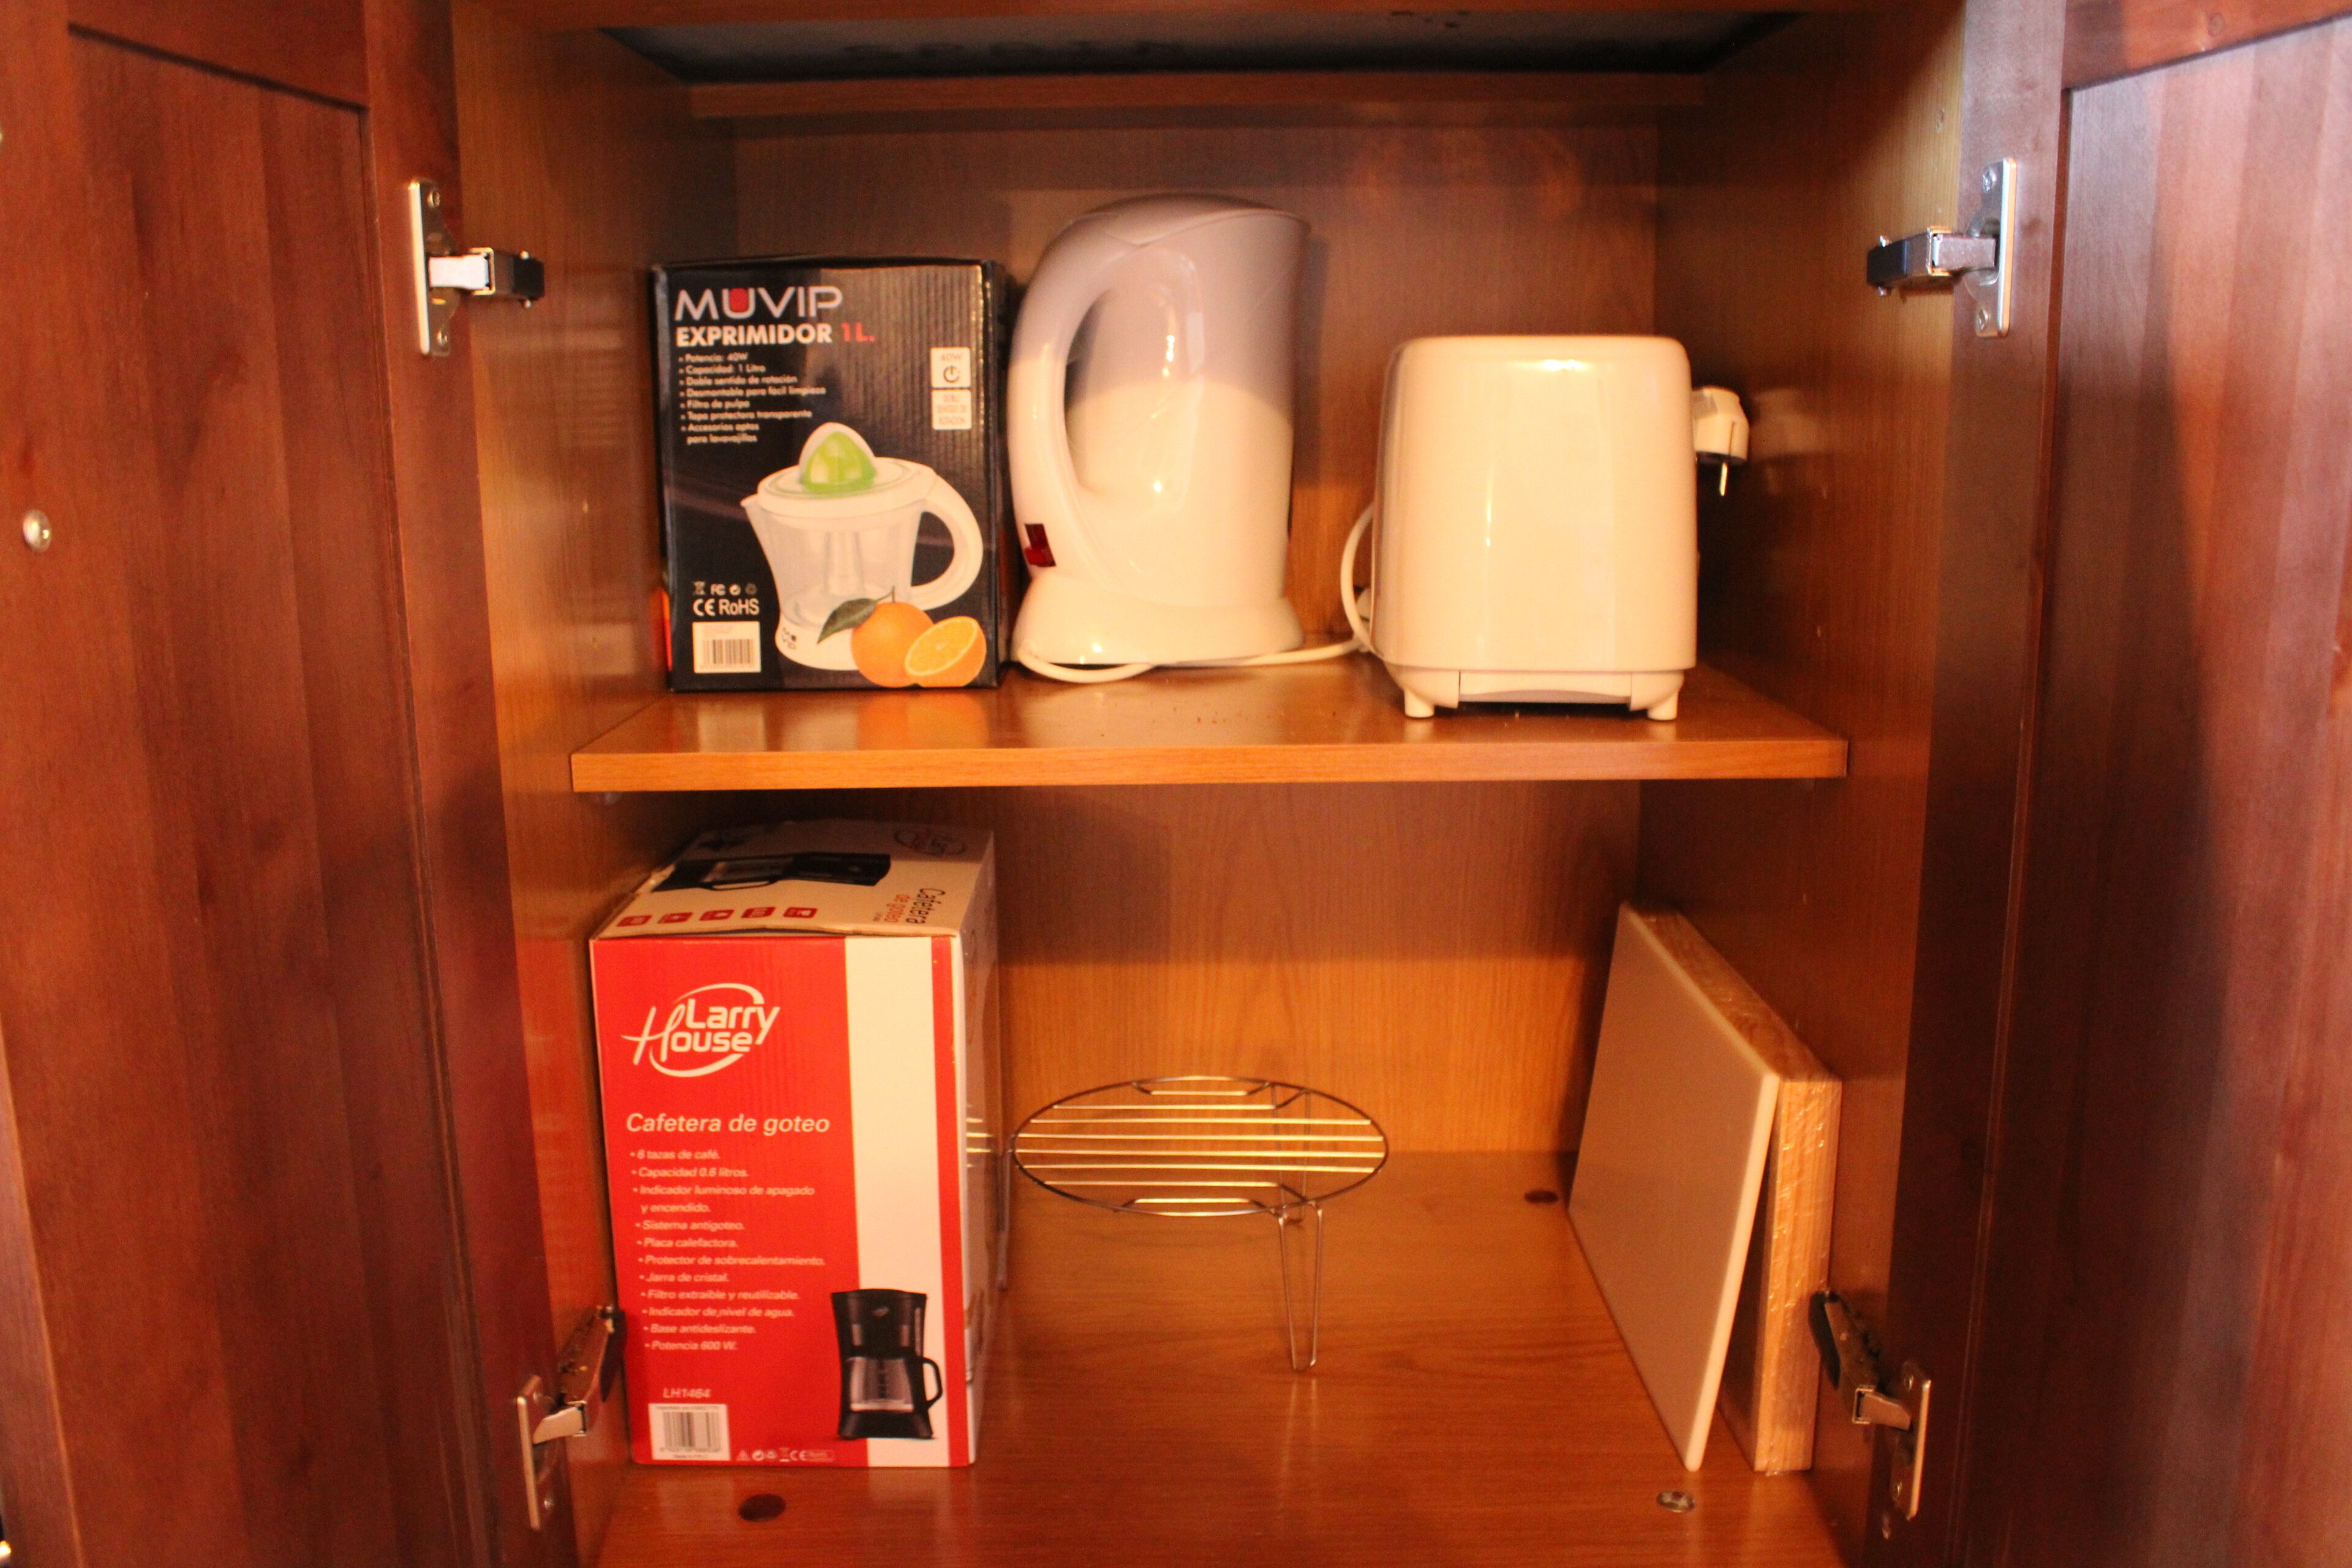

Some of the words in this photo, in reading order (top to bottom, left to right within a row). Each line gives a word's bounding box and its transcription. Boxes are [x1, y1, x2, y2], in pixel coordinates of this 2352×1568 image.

[676, 286, 842, 321] MUVIP
[676, 323, 832, 347] EXPRIMIDOR
[727, 352, 748, 361] 40W
[686, 376, 712, 386] Doble
[714, 376, 746, 385] sentido
[748, 375, 760, 384] de
[686, 388, 744, 398] Desmontable
[745, 388, 766, 397] para
[788, 386, 826, 396] limpieza
[687, 400, 709, 409] Filtro
[711, 399, 722, 408] de
[725, 399, 750, 409] pulpa
[688, 411, 708, 421] Tapa
[710, 411, 755, 420] protectora
[756, 410, 812, 420] transparente
[687, 436, 708, 445] para
[718, 598, 760, 616] RoHS
[907, 888, 946, 924] Cafetera
[685, 998, 781, 1045] Larry
[620, 1003, 753, 1065] House
[627, 1114, 722, 1132] Cafetera
[728, 1114, 756, 1132] de
[763, 1117, 829, 1136] goteo
[637, 1150, 645, 1159] 6
[677, 1150, 692, 1159] de
[694, 1150, 720, 1159] café.
[638, 1167, 697, 1178] Capacidad
[699, 1167, 716, 1177] 0.6
[718, 1167, 748, 1177] litros.
[639, 1185, 692, 1194] Indicador
[695, 1185, 747, 1194] luminoso
[749, 1185, 764, 1194] de
[766, 1185, 815, 1197] apagado
[641, 1205, 648, 1214] y
[650, 1203, 710, 1212] encendido.
[643, 1220, 688, 1230] Sistema
[690, 1220, 745, 1232] antigoteo.
[644, 1238, 674, 1247] Placa
[675, 1238, 738, 1247] calefactora.
[645, 1255, 695, 1265] Protector
[698, 1256, 712, 1265] de
[714, 1256, 826, 1265] sobrecalentamiento.
[646, 1273, 675, 1282] Jarra
[677, 1273, 692, 1282] de
[693, 1273, 728, 1282] cristal.
[647, 1289, 676, 1299] Filtro
[728, 1292, 734, 1301] y
[737, 1290, 799, 1299] reutilizable.
[649, 1307, 701, 1316] Indicador
[748, 1308, 763, 1316] de
[764, 1309, 793, 1319] agua.
[650, 1324, 677, 1333] Base
[652, 1341, 698, 1350] Potencia
[701, 1341, 720, 1350] 600
